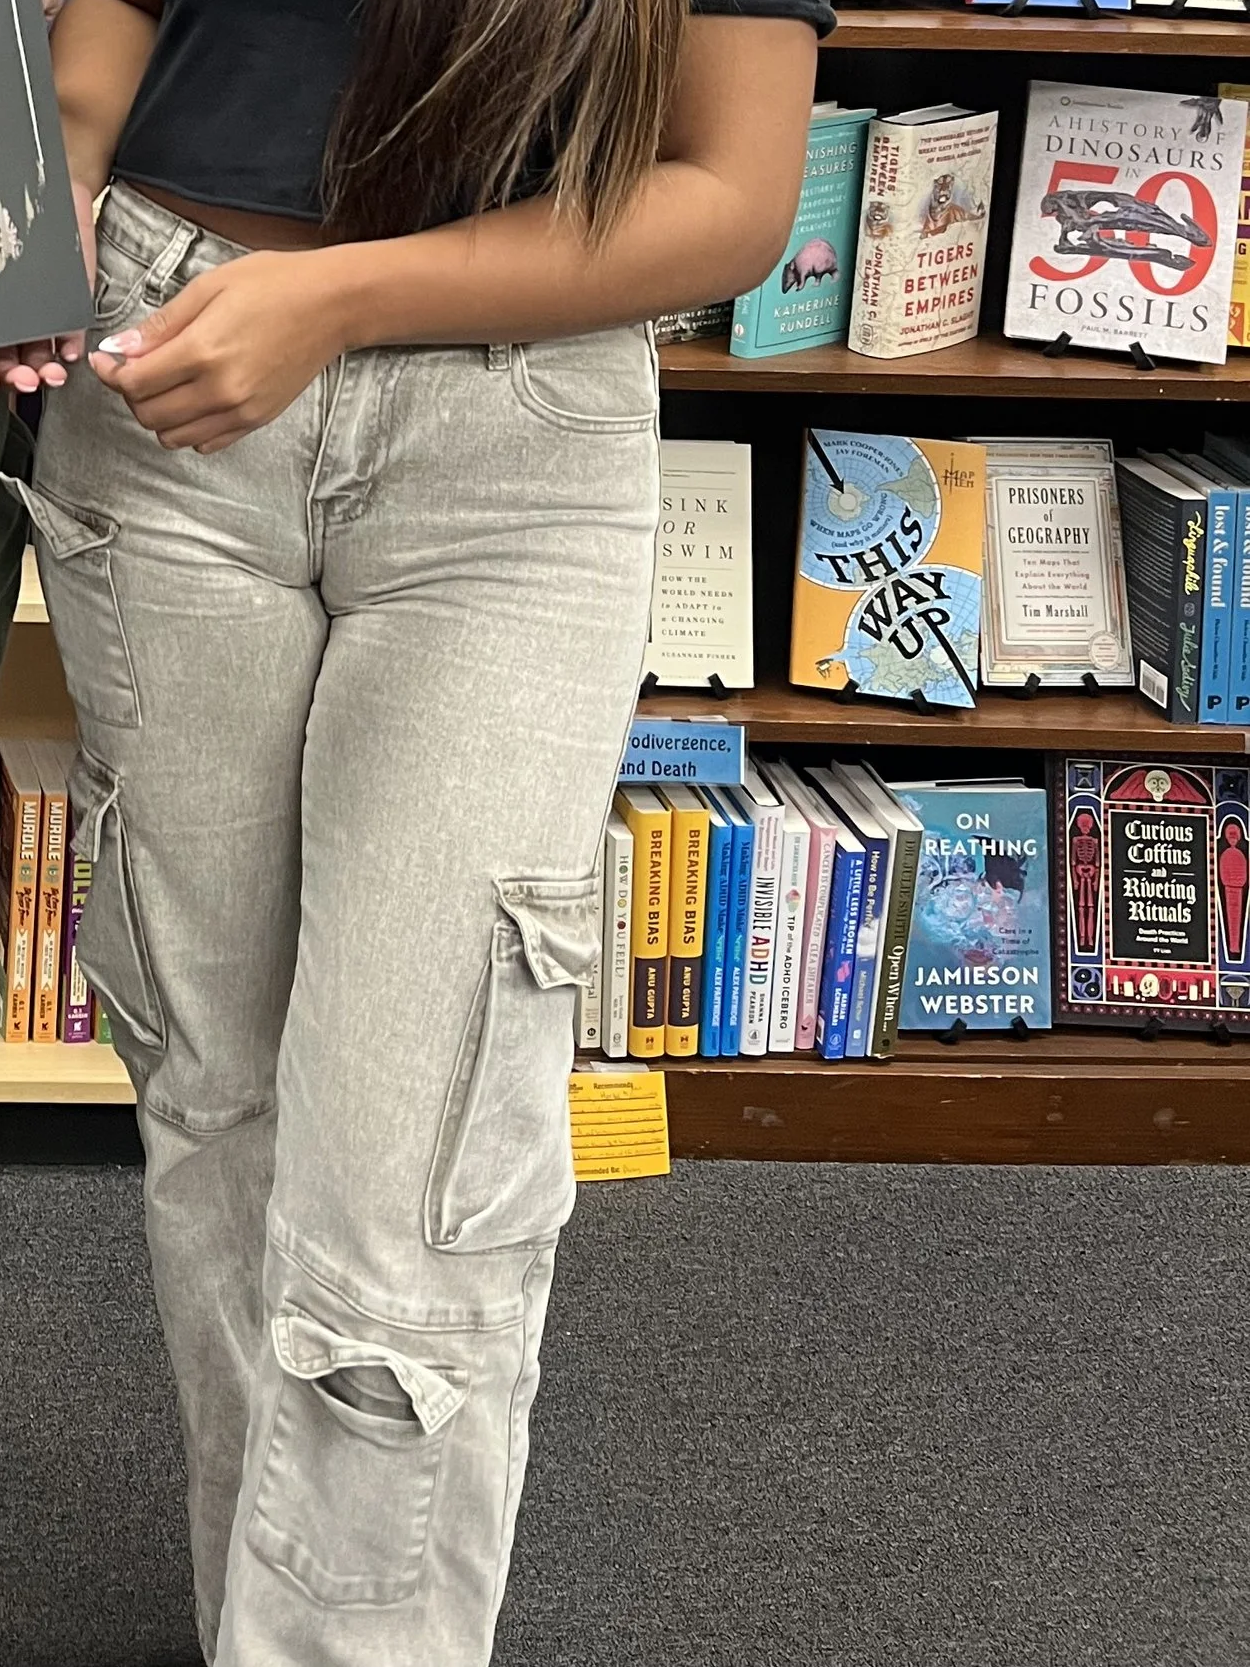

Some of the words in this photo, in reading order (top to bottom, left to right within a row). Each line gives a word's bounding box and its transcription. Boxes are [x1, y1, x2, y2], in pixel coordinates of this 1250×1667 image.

[1069, 115, 1183, 141] HISTORY
[1045, 134, 1223, 172] DINOSAURS
[1028, 160, 1218, 297] 50
[917, 242, 975, 268] TIGERS
[904, 263, 978, 294] BETWEEN
[773, 294, 840, 319] KATHERINE
[904, 287, 975, 317] EMPIRES
[1029, 283, 1209, 333] FOSSILS
[779, 314, 832, 333] RUNDELL
[899, 320, 941, 336] JONATHAN
[823, 439, 849, 447] MARK
[835, 448, 850, 456] JAY
[851, 449, 890, 473] FOREMAN
[663, 497, 728, 513] SINK
[873, 492, 888, 522] WRONG
[1008, 487, 1085, 505] PRISONERS
[663, 520, 696, 535] OR
[1043, 509, 1054, 522] of
[1213, 505, 1231, 535] lost
[814, 506, 923, 584] THIS
[1008, 527, 1091, 545] GEOGRAPHY
[663, 544, 734, 560] SWIM
[1023, 558, 1037, 566] Ten
[1039, 559, 1061, 567] Maps
[1063, 558, 1080, 566] That
[1015, 571, 1045, 580] Explain
[1047, 571, 1090, 581] Everything
[1064, 583, 1088, 591] World
[1210, 558, 1228, 608] found
[701, 590, 733, 598] NEEDS
[857, 571, 952, 643] WAY
[1022, 604, 1041, 618] Tim
[1045, 604, 1089, 618] Marshall
[671, 616, 725, 624] CHANGING
[662, 629, 706, 637] CLIMATE
[651, 760, 698, 777] Death
[21, 801, 39, 861] MURDLE
[47, 801, 64, 862] MURDLE
[957, 813, 990, 830] ON
[1125, 820, 1194, 842] Curious
[925, 839, 1037, 857] REATHING
[1128, 843, 1191, 865] Coffins
[648, 830, 663, 906] BREAKING
[685, 830, 701, 906] BREAKING
[1151, 867, 1167, 877] and
[753, 877, 775, 930] INVISIBLE
[1123, 877, 1197, 905] Riveting
[1128, 900, 1191, 923] Rituals
[647, 911, 660, 945] BIAS
[683, 910, 697, 944] BIAS
[846, 919, 857, 954] BROKEN
[749, 936, 771, 985] ADHD
[783, 954, 793, 983] ADHD
[888, 945, 904, 980] Open
[647, 966, 657, 987] ANU
[683, 966, 693, 986] ANU
[915, 967, 1038, 985] JAMIESON
[646, 988, 657, 1020] GUPTA
[681, 987, 692, 1019] GUPTA
[780, 984, 790, 1030] ICEBERG
[920, 995, 1034, 1014] WEBSTER
